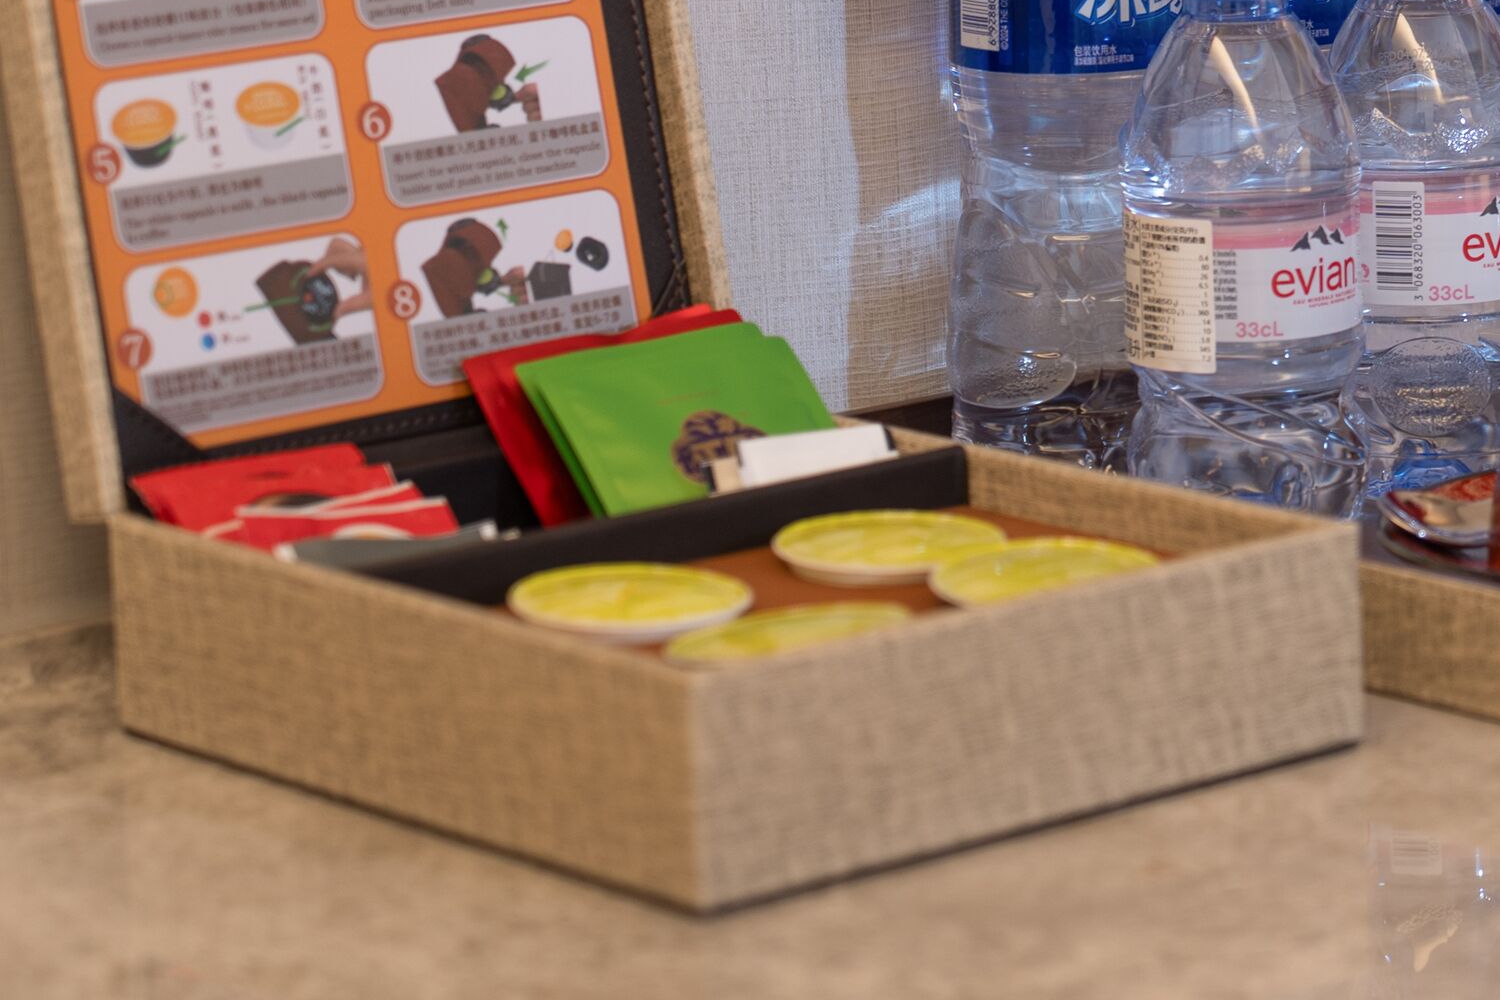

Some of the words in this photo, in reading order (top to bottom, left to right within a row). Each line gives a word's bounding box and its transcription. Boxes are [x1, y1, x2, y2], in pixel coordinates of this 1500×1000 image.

[368, 3, 424, 20] packaging
[990, 37, 997, 46] 6
[363, 108, 385, 139] 6
[91, 149, 116, 181] 5
[447, 162, 473, 175] white
[519, 151, 543, 163] close
[546, 148, 562, 159] the
[565, 142, 600, 158] capsule
[517, 166, 532, 177] the
[536, 160, 576, 175] machine
[1413, 194, 1423, 238] 063003
[1271, 257, 1357, 298] evian
[1413, 244, 1423, 287] 068320
[393, 284, 417, 317] 8
[1428, 284, 1474, 301] 33cL
[1235, 320, 1284, 338] 33cL
[121, 333, 144, 366] 7
